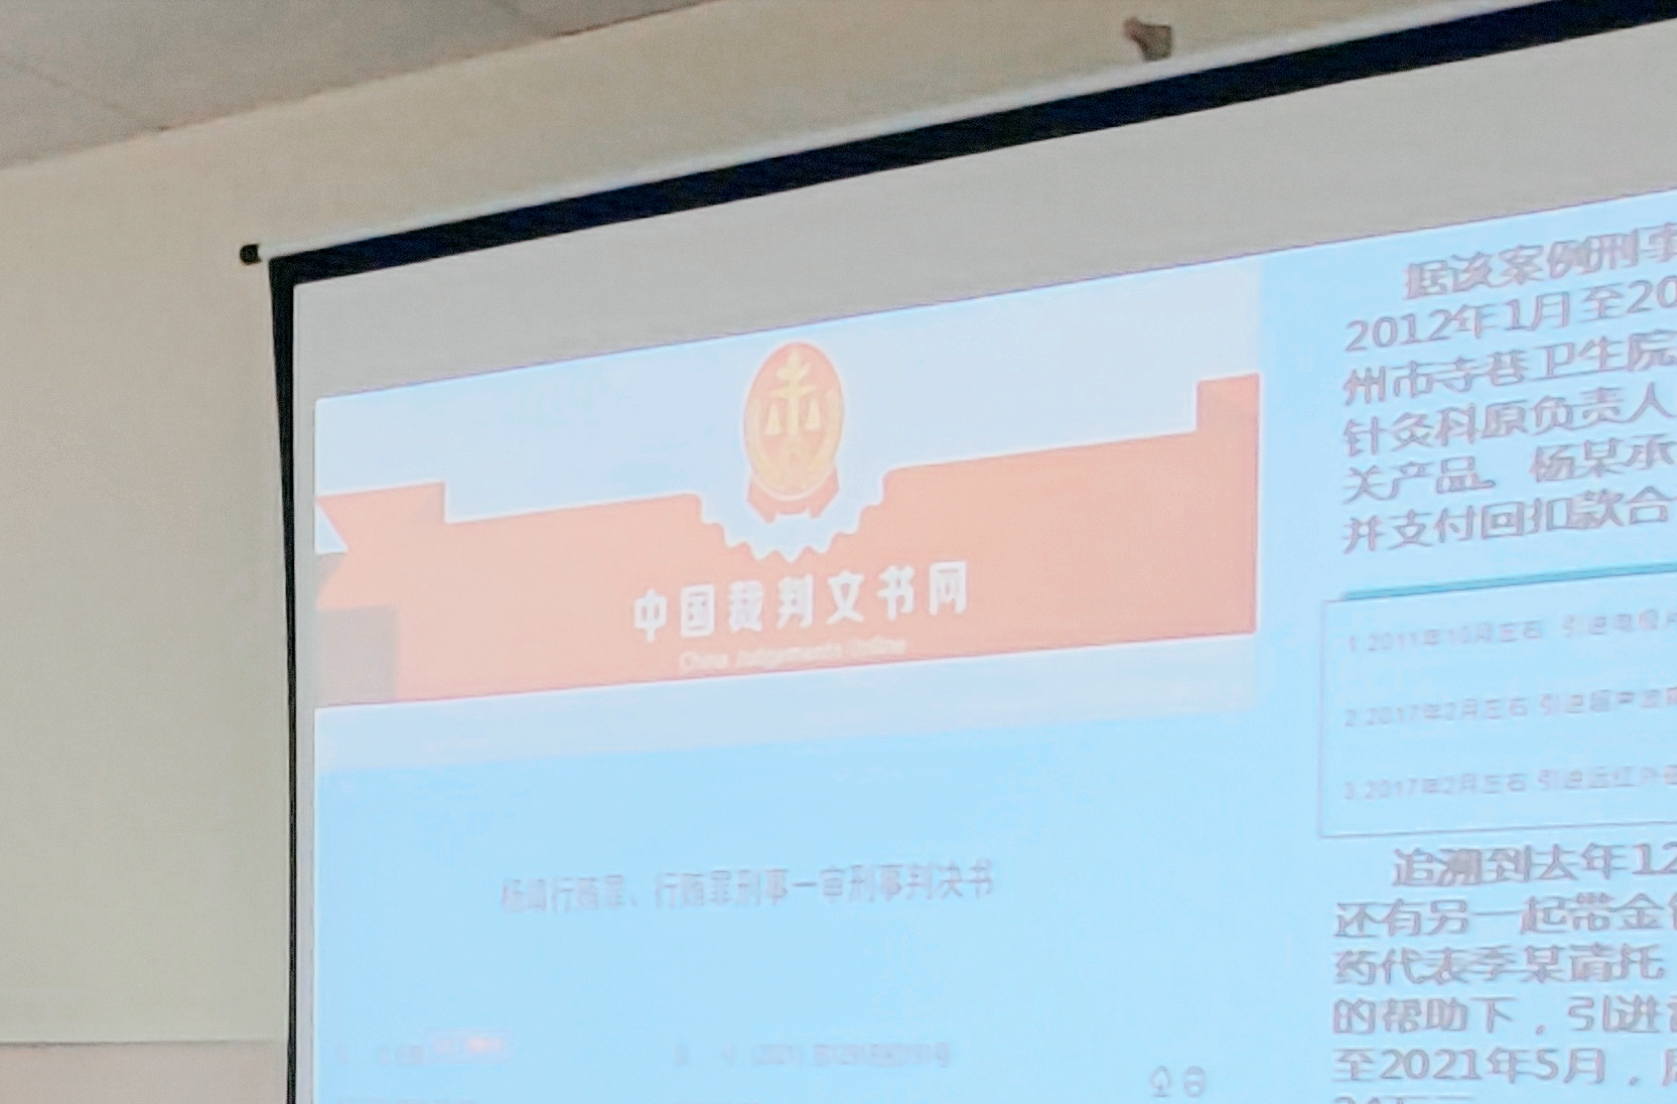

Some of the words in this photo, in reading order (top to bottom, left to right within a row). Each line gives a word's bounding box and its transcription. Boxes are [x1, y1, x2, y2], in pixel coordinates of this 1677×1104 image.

[1343, 329, 1677, 406] 州市寺巷卫生院
[1343, 381, 1677, 457] 针灸科原负责人
[1343, 486, 1677, 554] 并支付回扣款合
[633, 561, 968, 643] 中国裁判文书网
[1333, 996, 1677, 1035] 的帮助下，引进
